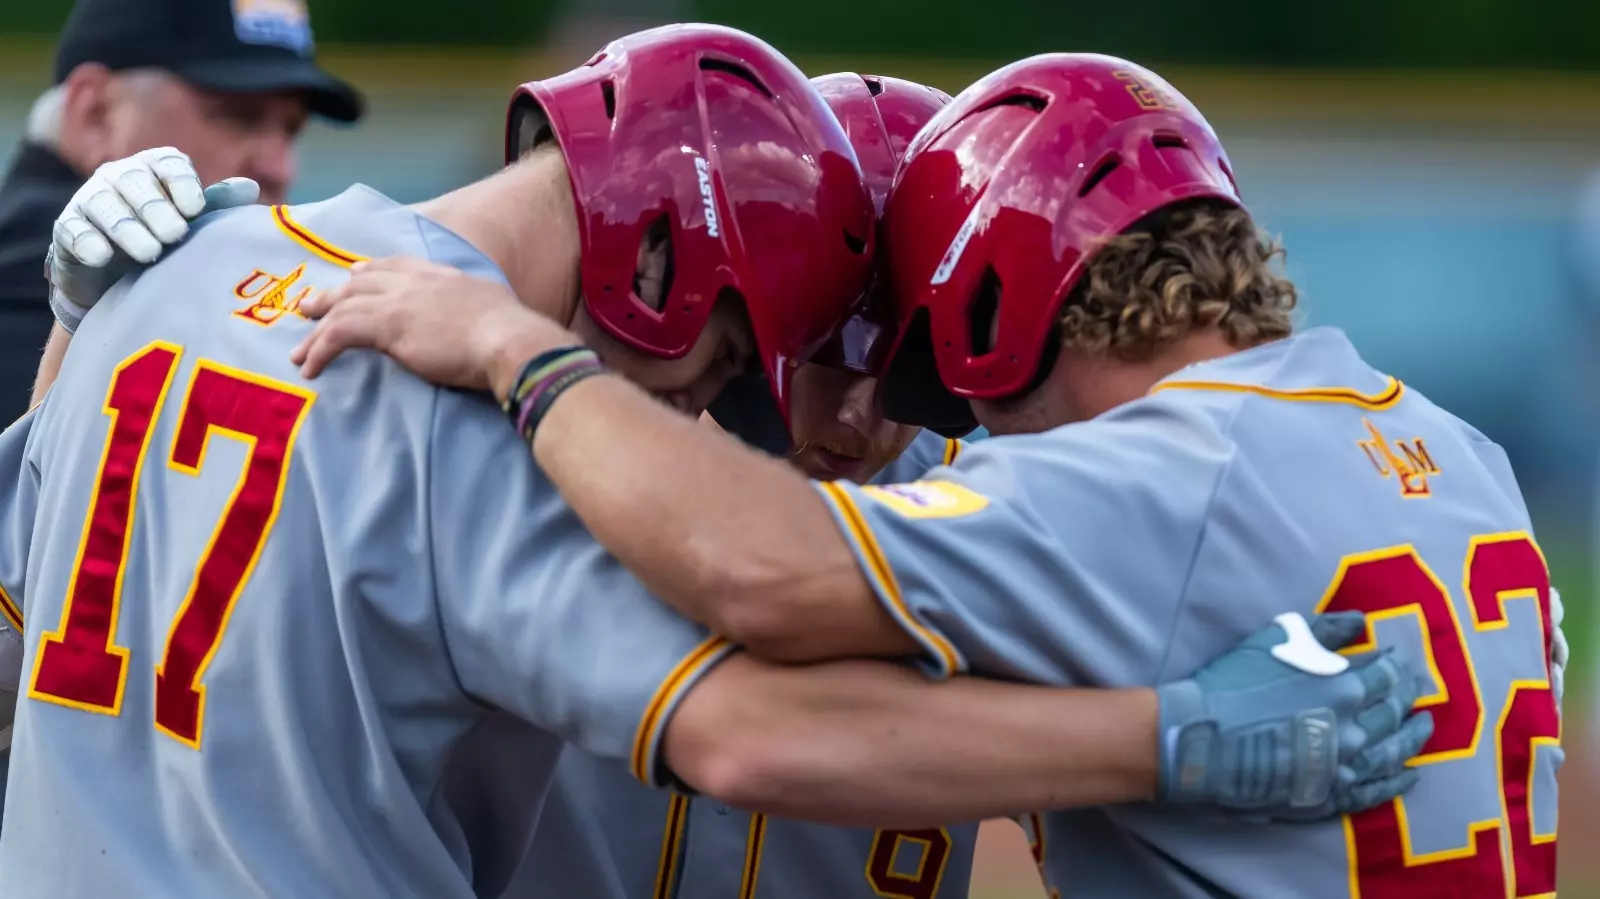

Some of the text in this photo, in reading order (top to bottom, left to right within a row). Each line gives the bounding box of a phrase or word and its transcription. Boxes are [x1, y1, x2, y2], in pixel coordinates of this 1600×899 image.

[695, 157, 719, 238] EASTON
[28, 339, 318, 751] 17
[1313, 529, 1561, 899] 22
